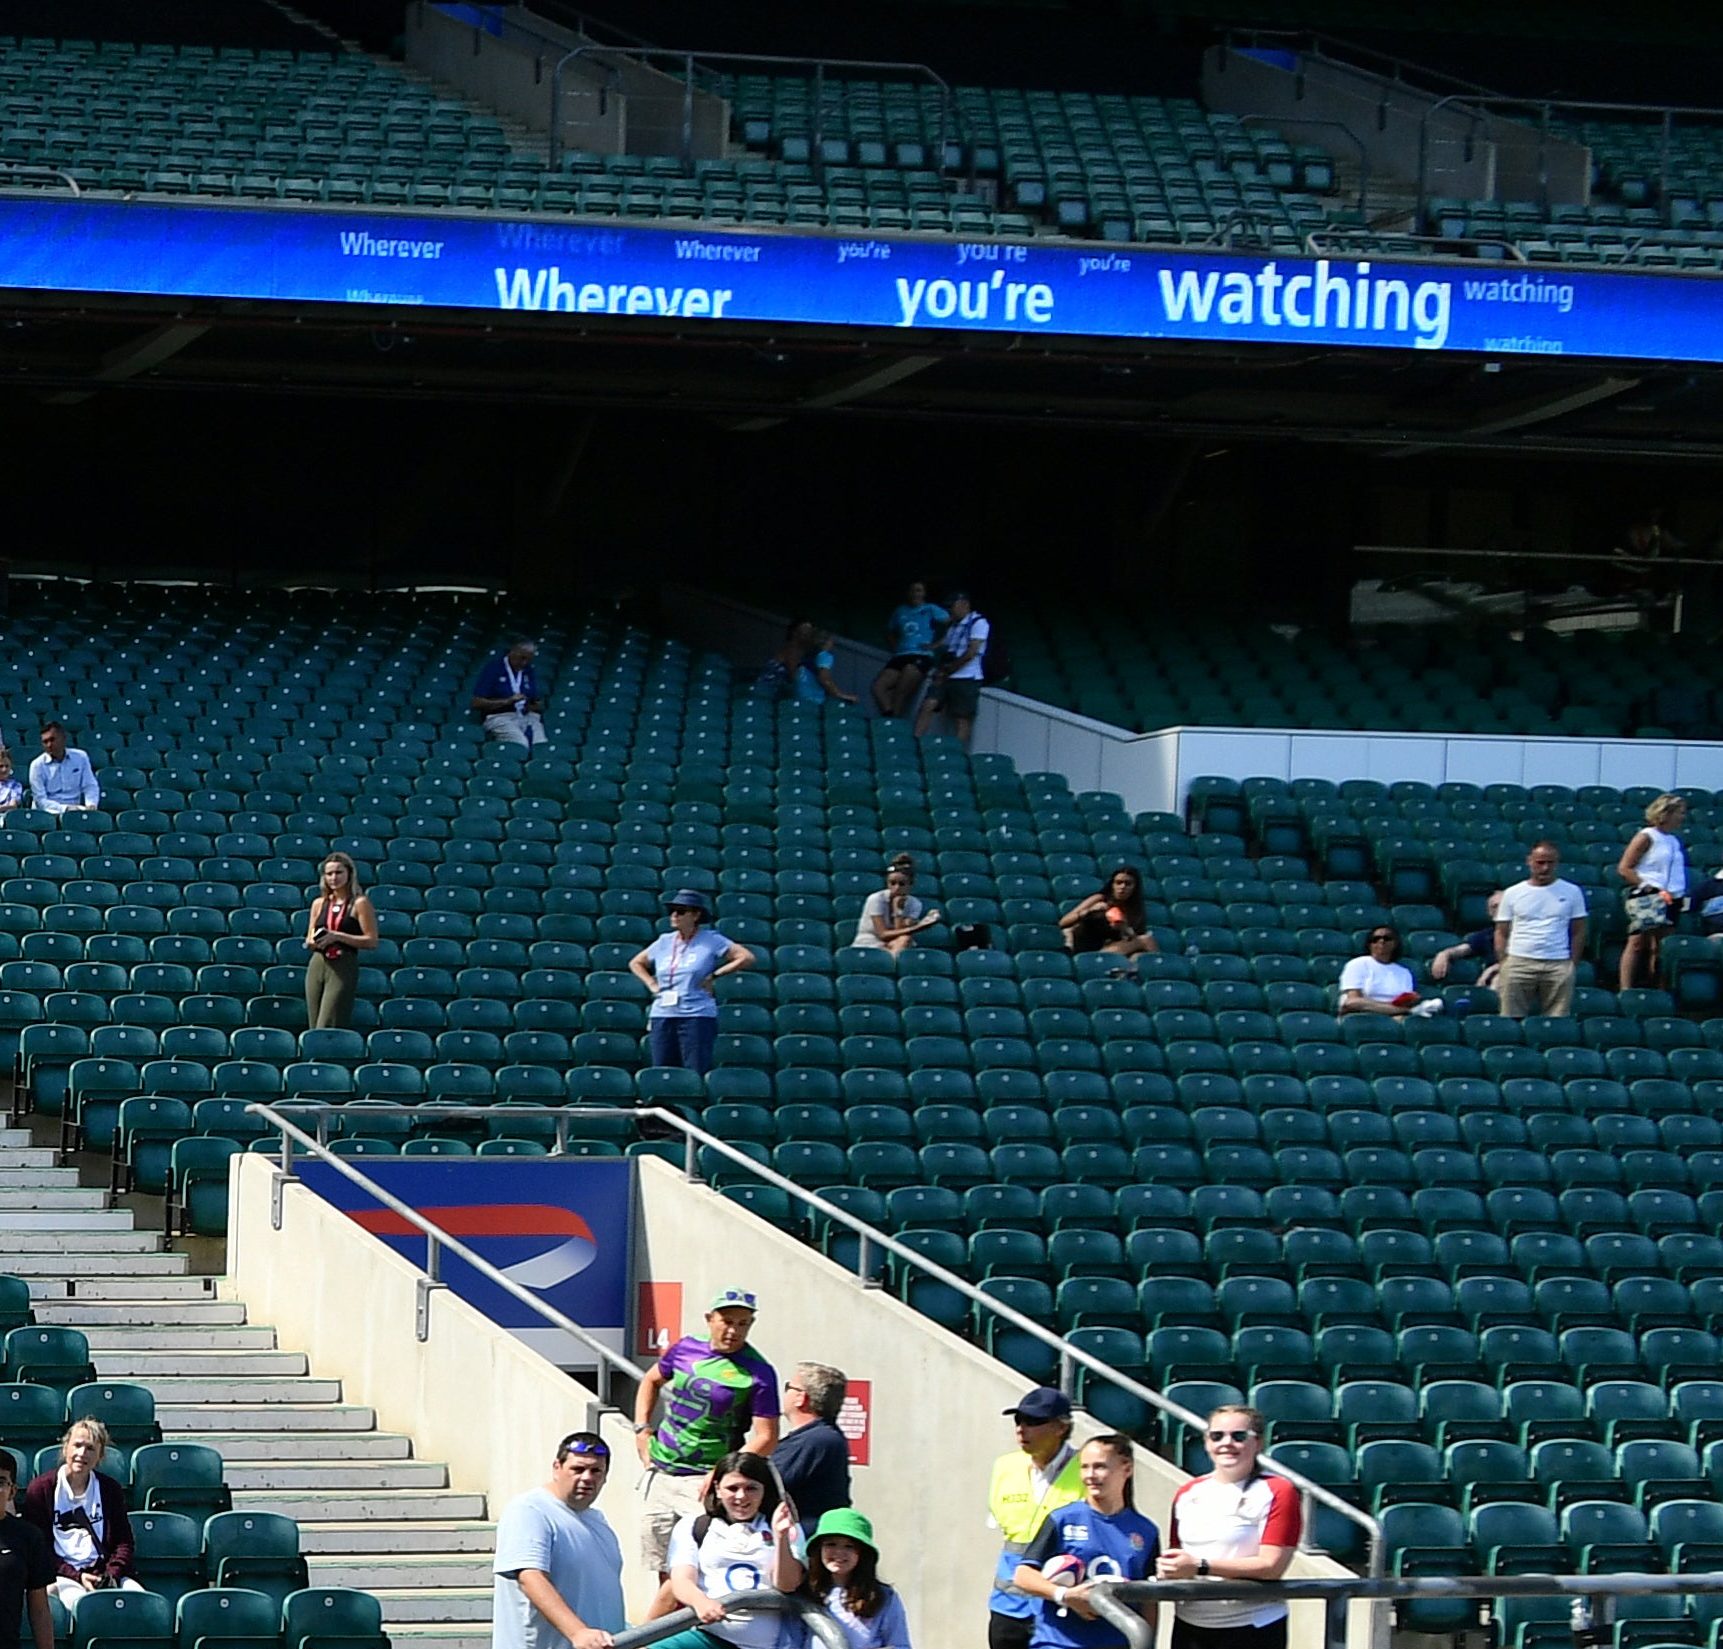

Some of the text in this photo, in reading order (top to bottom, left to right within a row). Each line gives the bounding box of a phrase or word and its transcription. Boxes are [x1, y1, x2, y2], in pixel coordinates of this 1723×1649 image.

[340, 231, 443, 260] Wherever
[675, 239, 760, 264] Wherever
[494, 260, 1451, 349] Wherever you're watching
[1463, 277, 1573, 312] watching
[648, 1328, 670, 1349] L4
